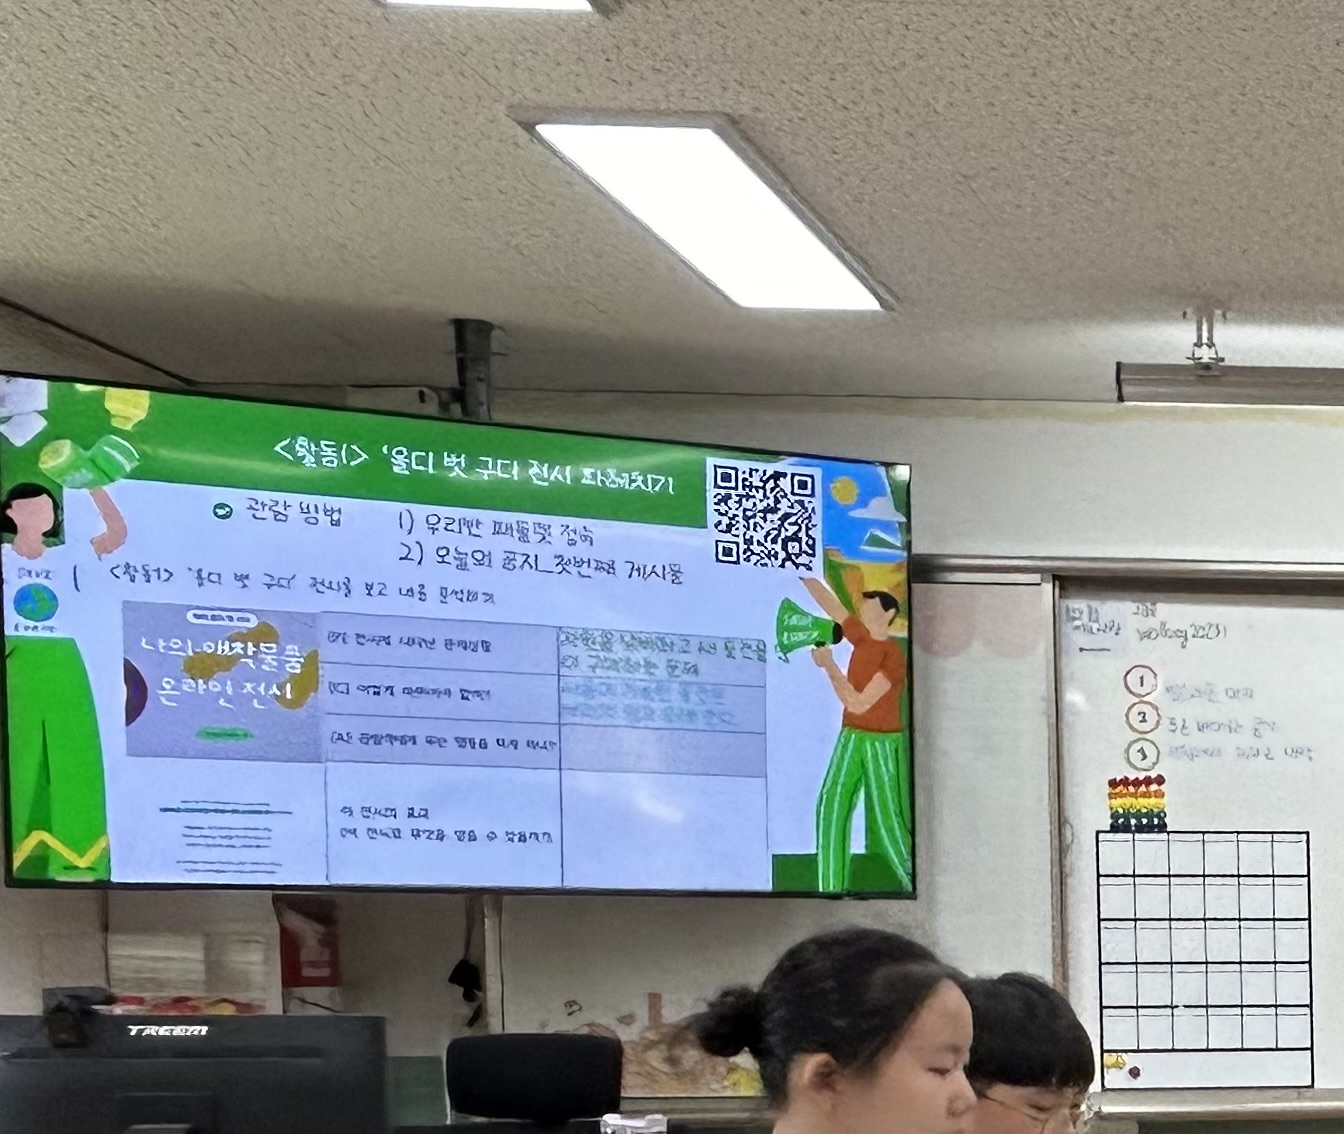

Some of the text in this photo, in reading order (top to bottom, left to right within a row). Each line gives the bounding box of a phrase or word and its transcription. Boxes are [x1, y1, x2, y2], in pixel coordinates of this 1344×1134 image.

[443, 452, 468, 478] 벗
[475, 456, 519, 481] 구디
[528, 459, 571, 486] 전시
[425, 513, 484, 539] 우리반
[435, 545, 493, 572] 오늘의
